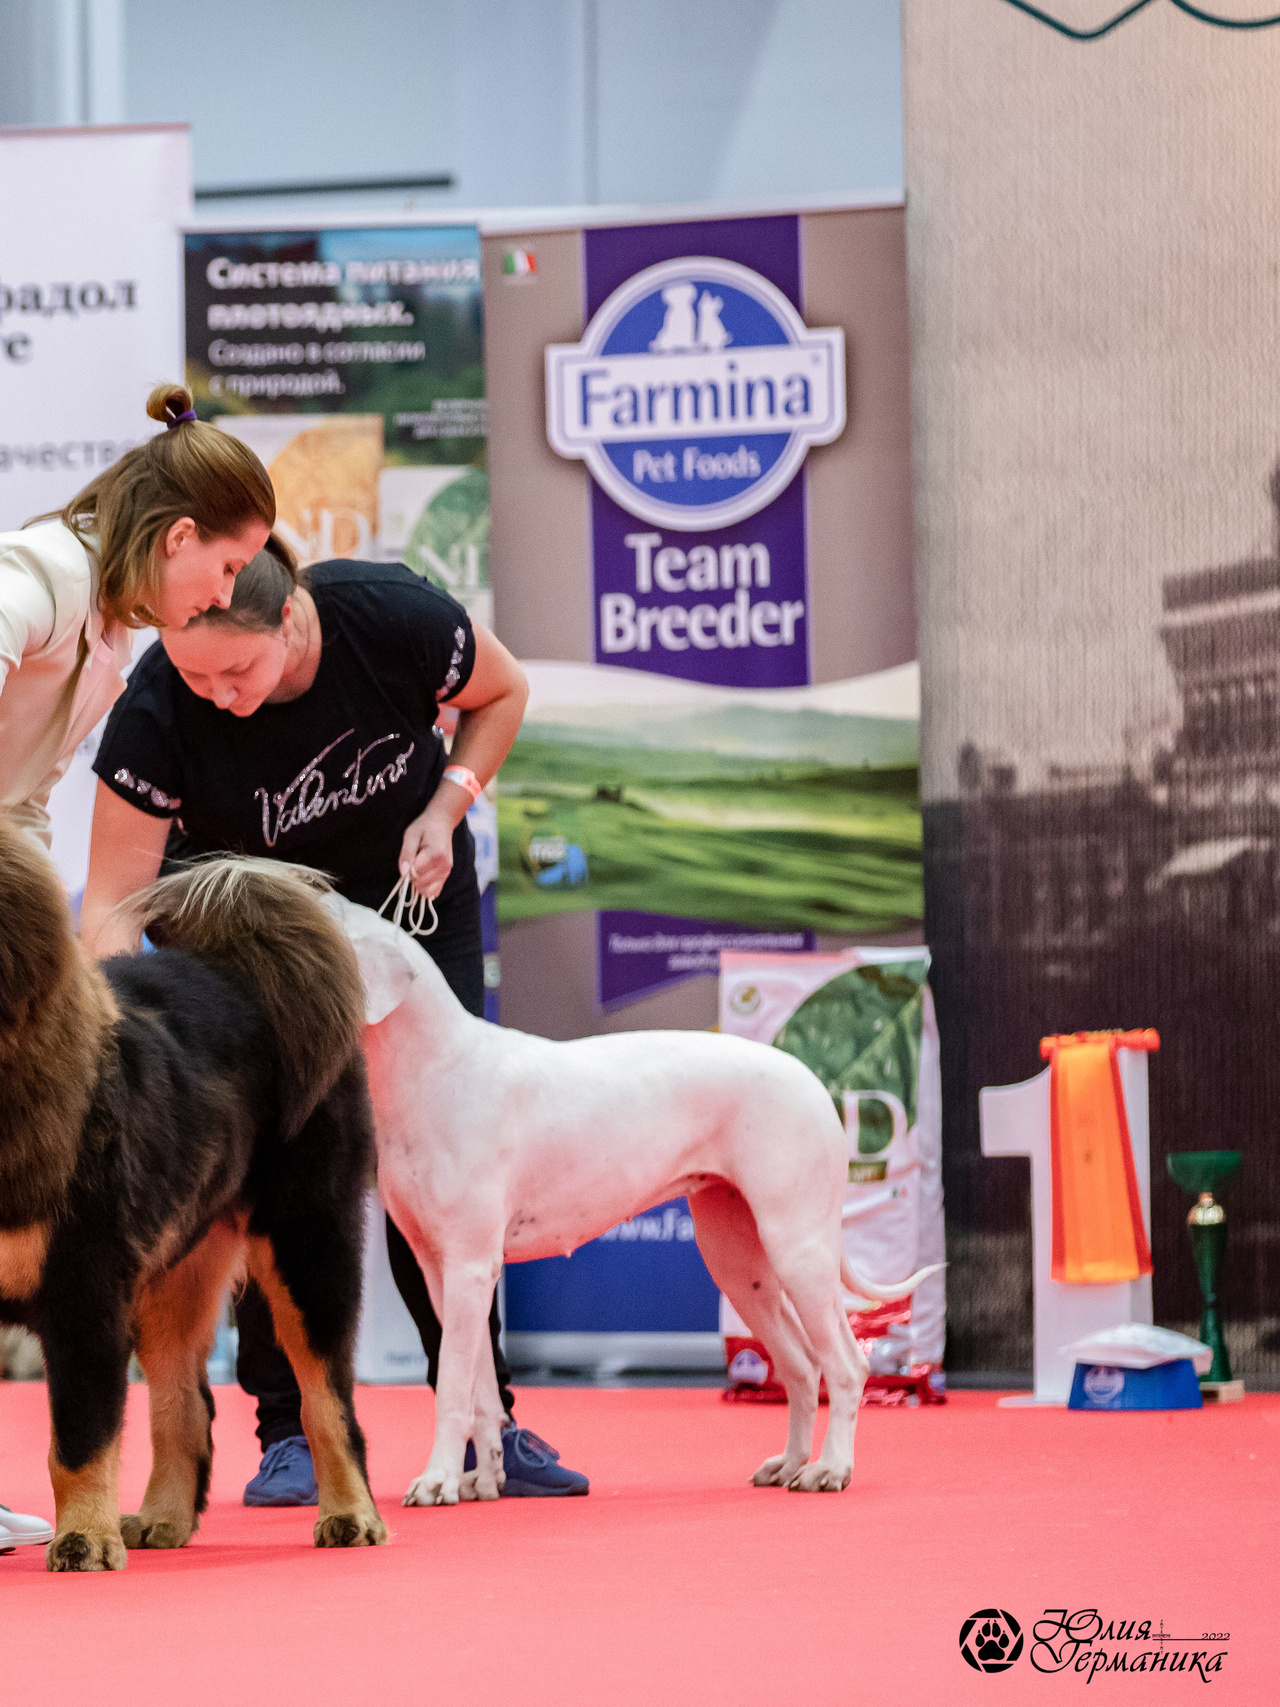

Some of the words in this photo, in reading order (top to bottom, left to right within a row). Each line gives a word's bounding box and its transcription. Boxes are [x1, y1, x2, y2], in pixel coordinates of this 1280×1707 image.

[205, 256, 341, 290] Система
[344, 259, 481, 286] питания
[206, 300, 415, 333] плотоядных.
[207, 338, 306, 367] Создано
[322, 341, 426, 364] согласии
[578, 361, 813, 428] Farmina
[631, 448, 677, 484] Pet
[682, 444, 762, 480] Foods
[623, 531, 772, 594] Team
[599, 587, 805, 654] Breeder
